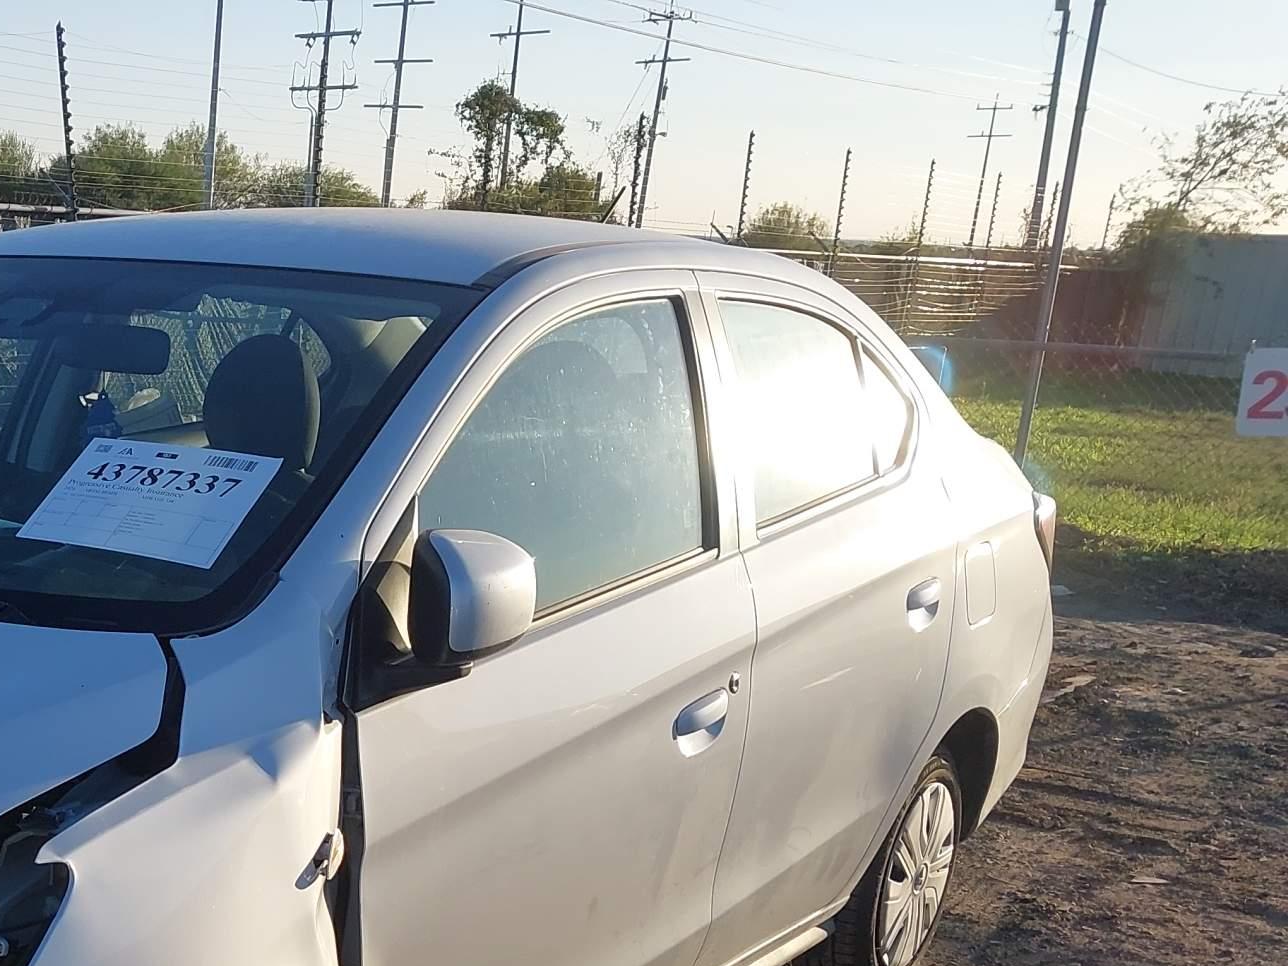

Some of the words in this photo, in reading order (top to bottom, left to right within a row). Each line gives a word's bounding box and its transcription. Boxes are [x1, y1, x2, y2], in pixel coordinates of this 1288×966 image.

[1247, 369, 1288, 420] 2
[67, 479, 112, 490] Progressive
[112, 482, 143, 494] Casualty
[145, 487, 185, 499] Insurance
[87, 461, 243, 498] 43787337
